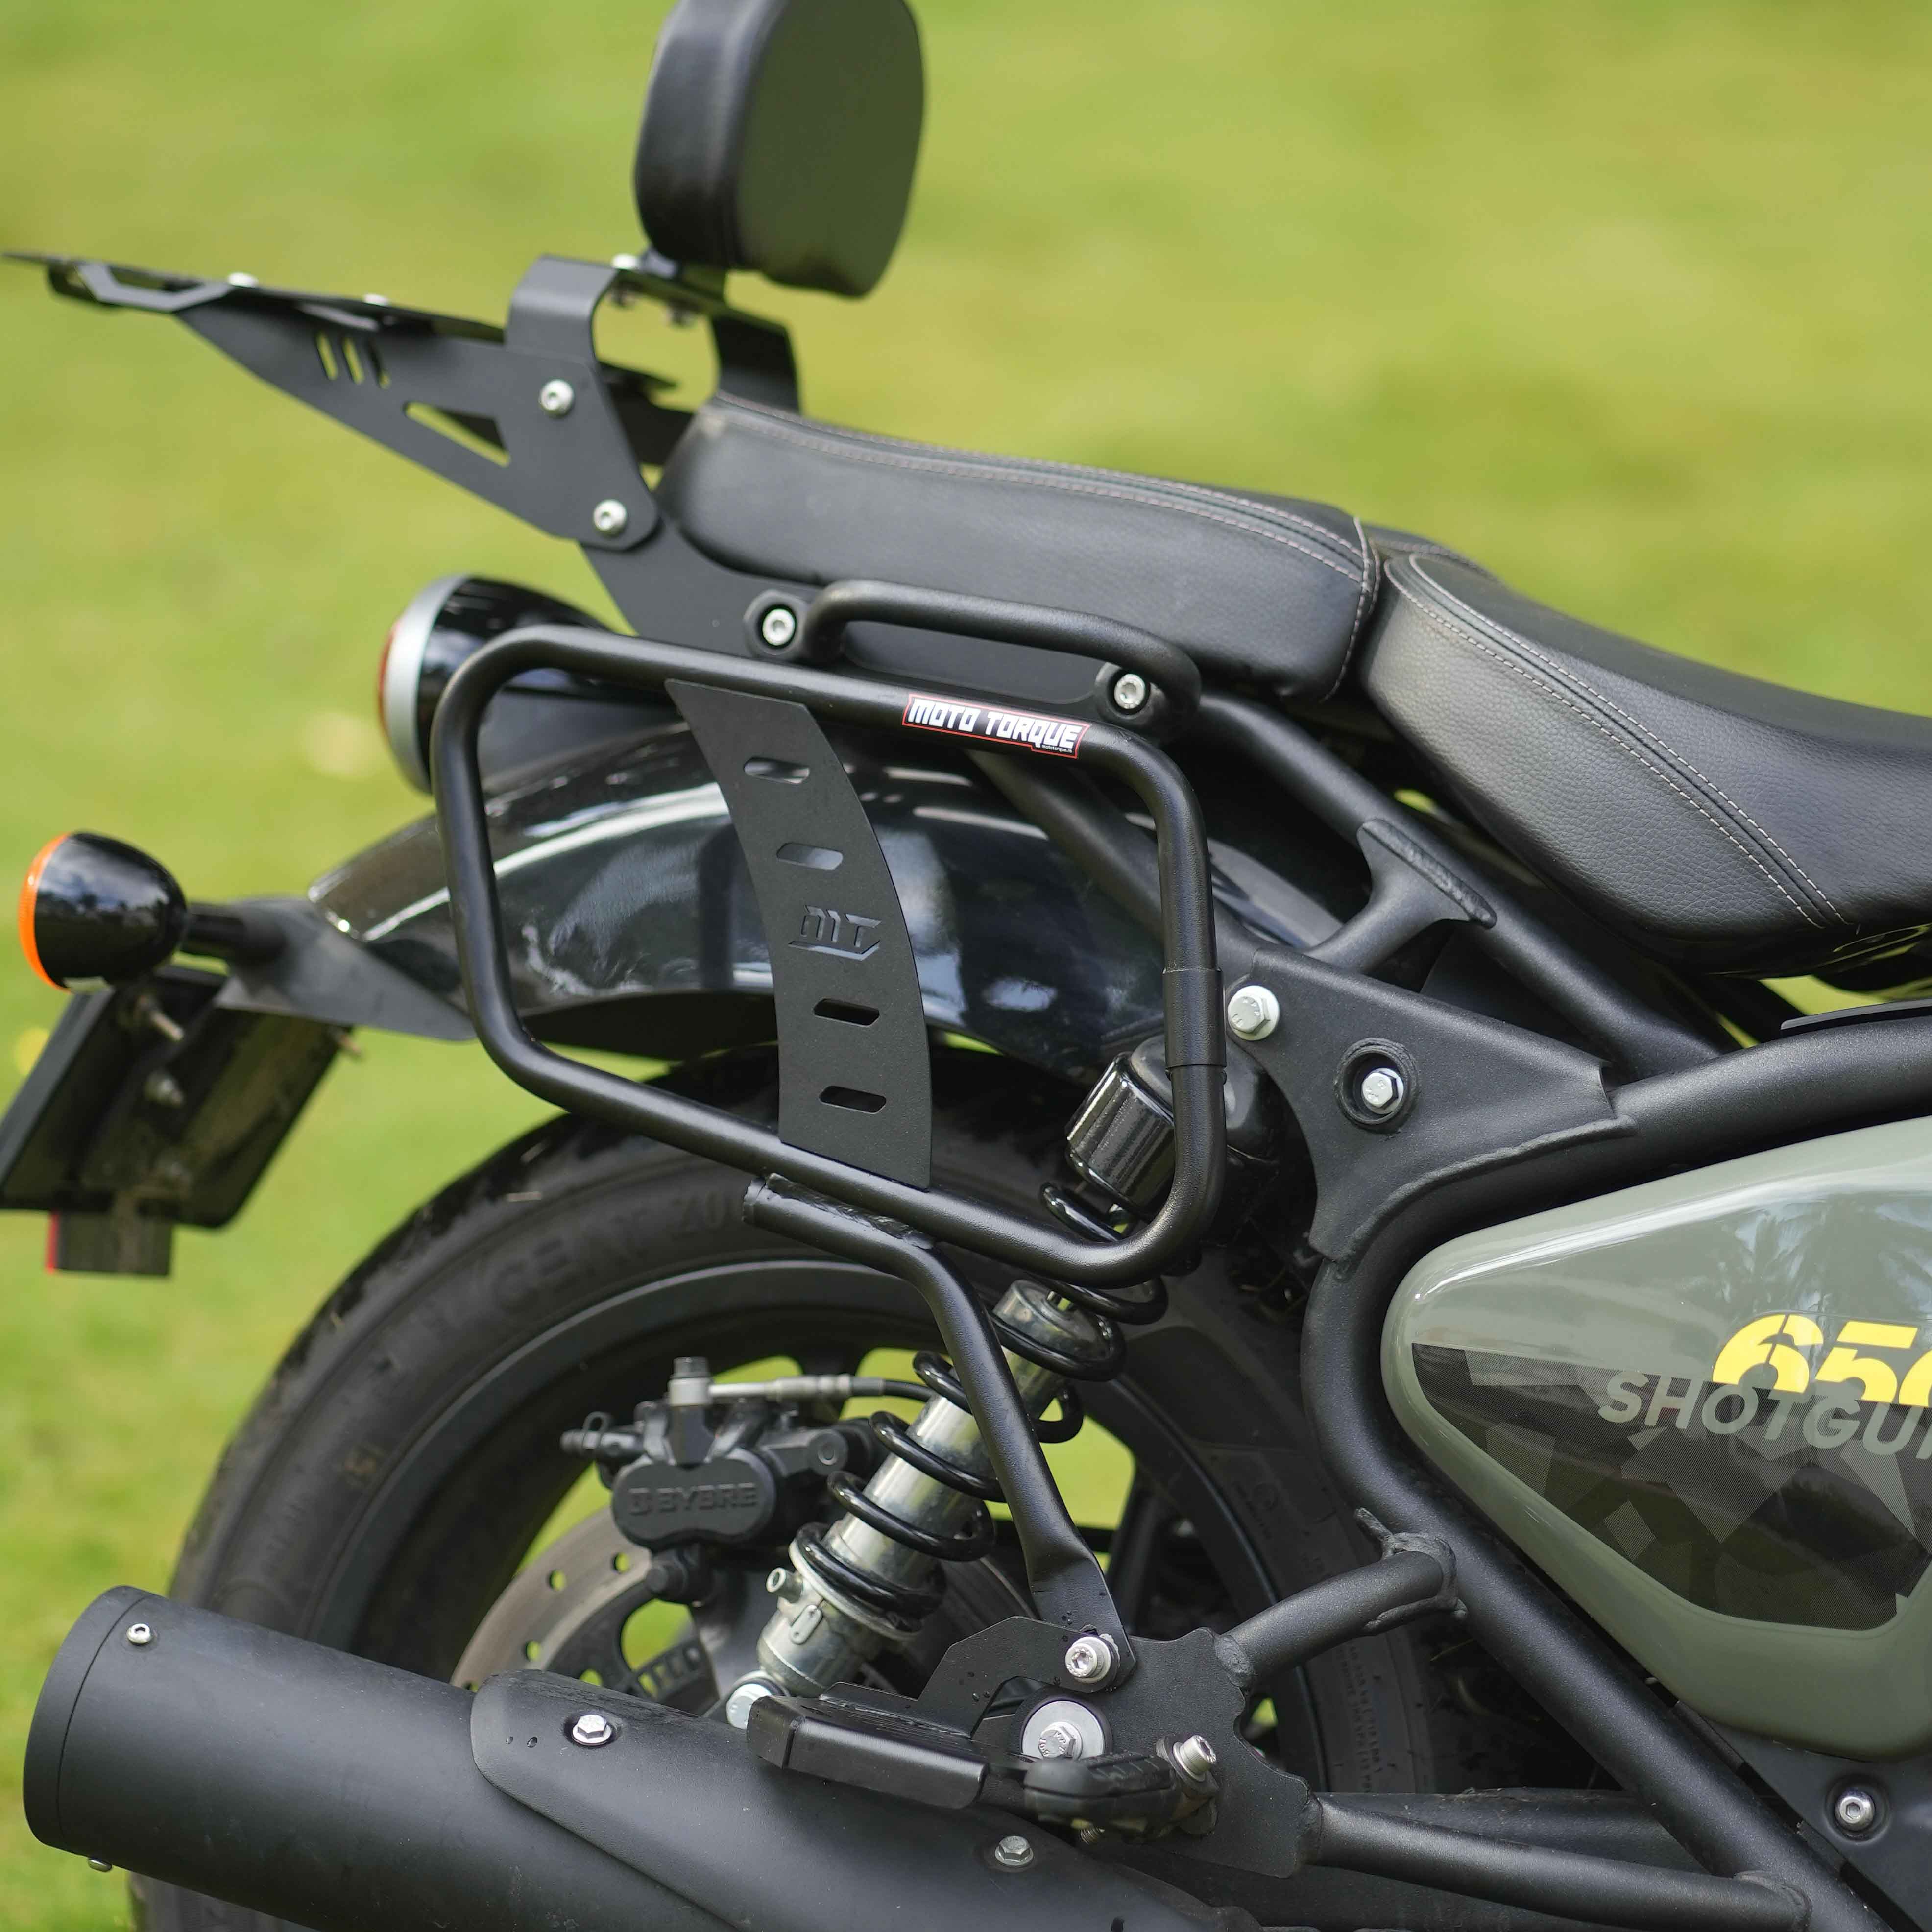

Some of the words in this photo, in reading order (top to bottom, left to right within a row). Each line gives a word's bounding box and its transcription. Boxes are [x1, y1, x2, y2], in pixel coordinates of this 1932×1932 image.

[908, 698, 981, 732] MOTO
[985, 711, 1083, 749] TORQUE
[1597, 1371, 1932, 1460] SHOTGU
[656, 1481, 758, 1513] BYBRE
